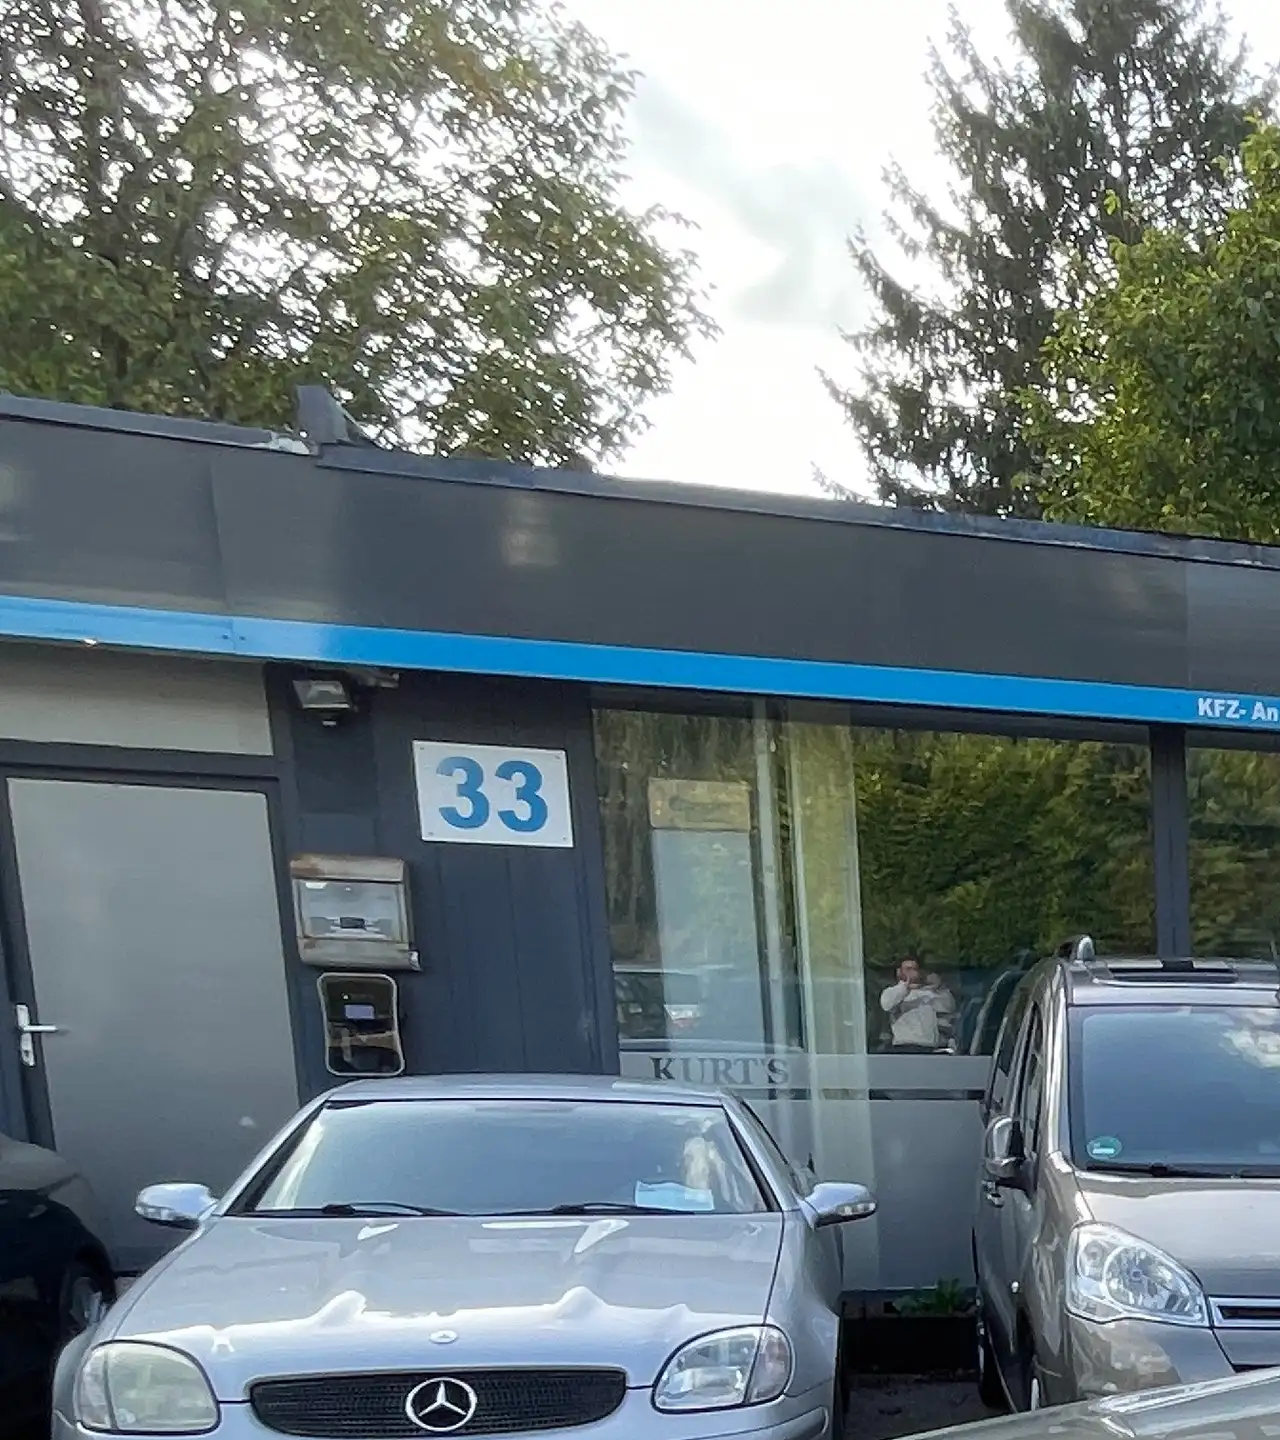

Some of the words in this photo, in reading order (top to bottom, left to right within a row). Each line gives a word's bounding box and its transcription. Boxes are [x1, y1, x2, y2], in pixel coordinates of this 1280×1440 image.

[1198, 697, 1247, 720] KFZ-
[1251, 701, 1279, 723] An
[435, 756, 549, 833] 33
[650, 1056, 789, 1085] KURT'S
